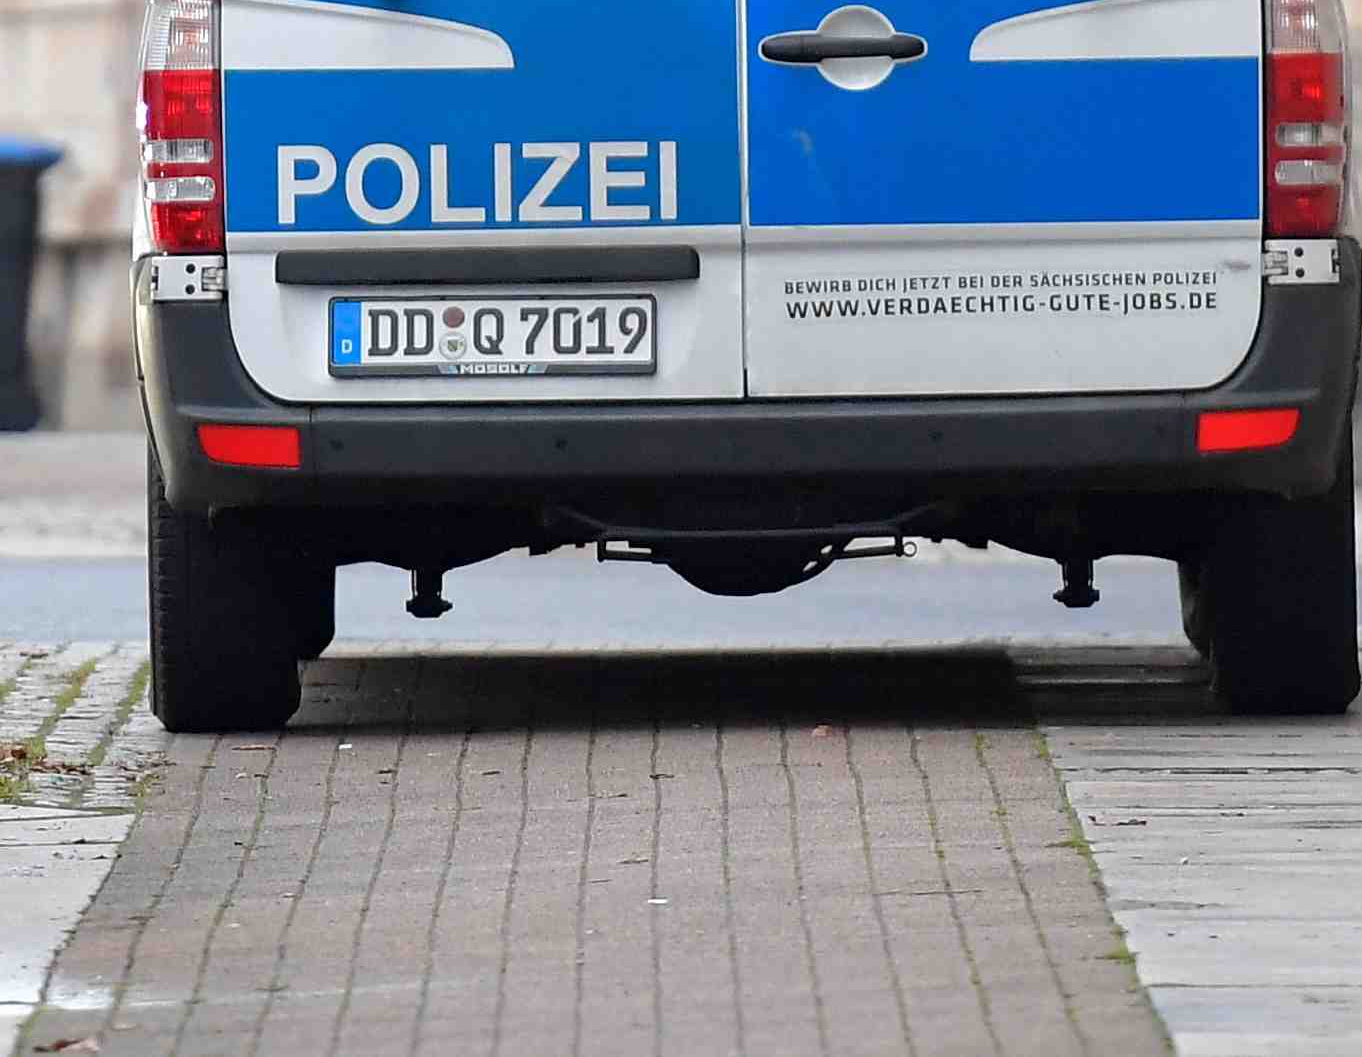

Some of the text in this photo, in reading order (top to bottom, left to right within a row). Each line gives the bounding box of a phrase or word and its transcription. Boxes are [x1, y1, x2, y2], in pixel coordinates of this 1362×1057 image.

[276, 140, 678, 225] POLIZEI
[784, 271, 1217, 295] BEWIRB DICH JETZT BEI DER SÄCHSISCHEN POLIZEI
[786, 292, 1217, 319] WWW.VERDAECHTIG-GUTE-JOBS.DE
[341, 306, 648, 356] D DD Q 7019
